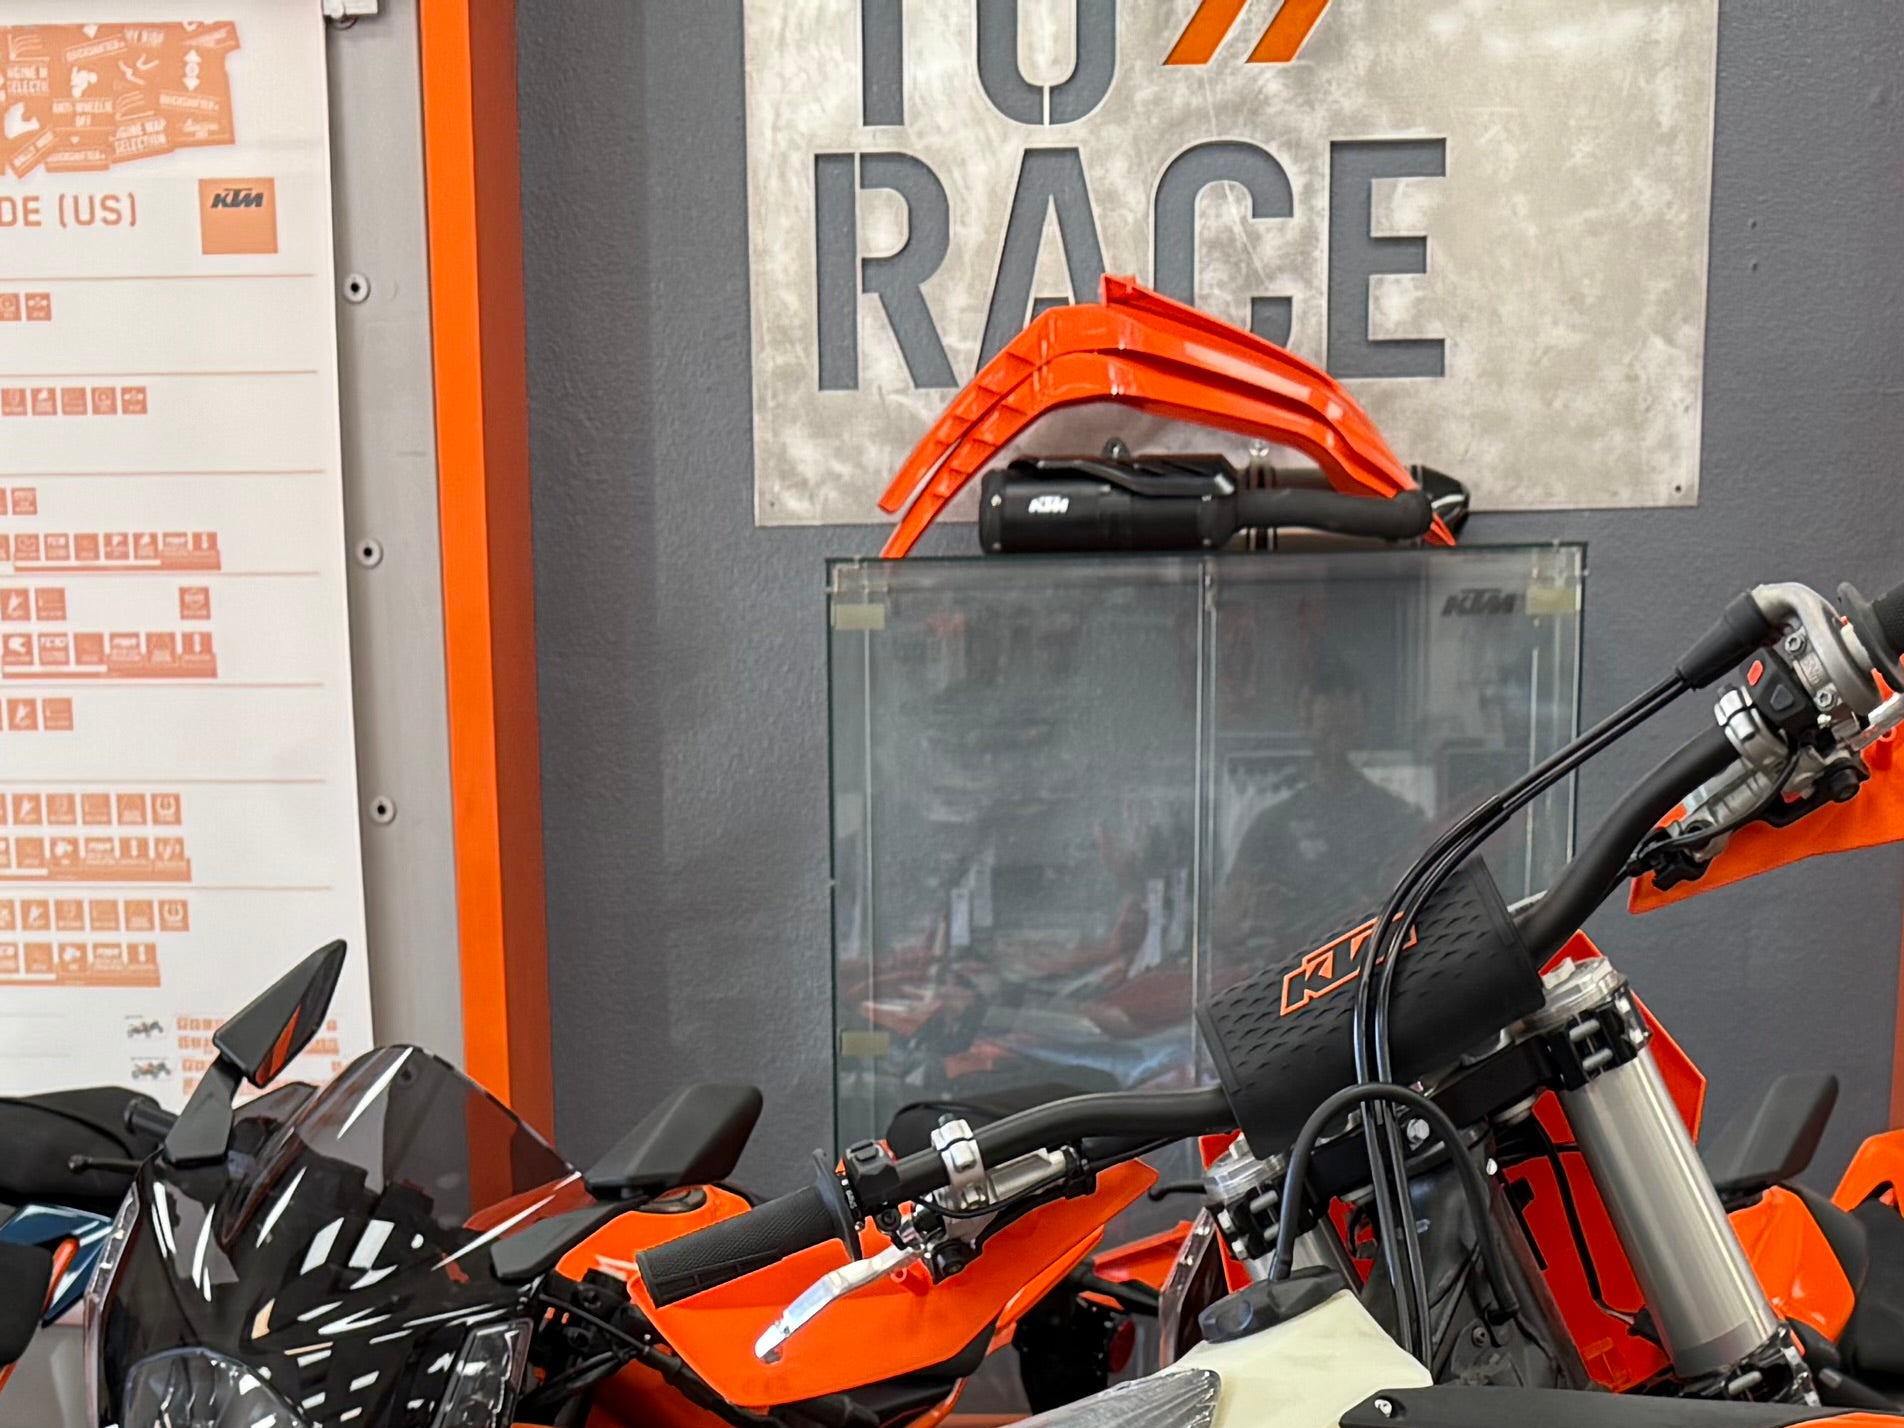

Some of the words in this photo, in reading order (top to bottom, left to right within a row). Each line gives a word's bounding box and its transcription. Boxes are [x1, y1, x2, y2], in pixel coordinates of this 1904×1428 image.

[58, 192, 138, 227] (US)
[210, 187, 264, 209] KTM
[815, 138, 1446, 391] RACE
[1441, 588, 1516, 617] KTM
